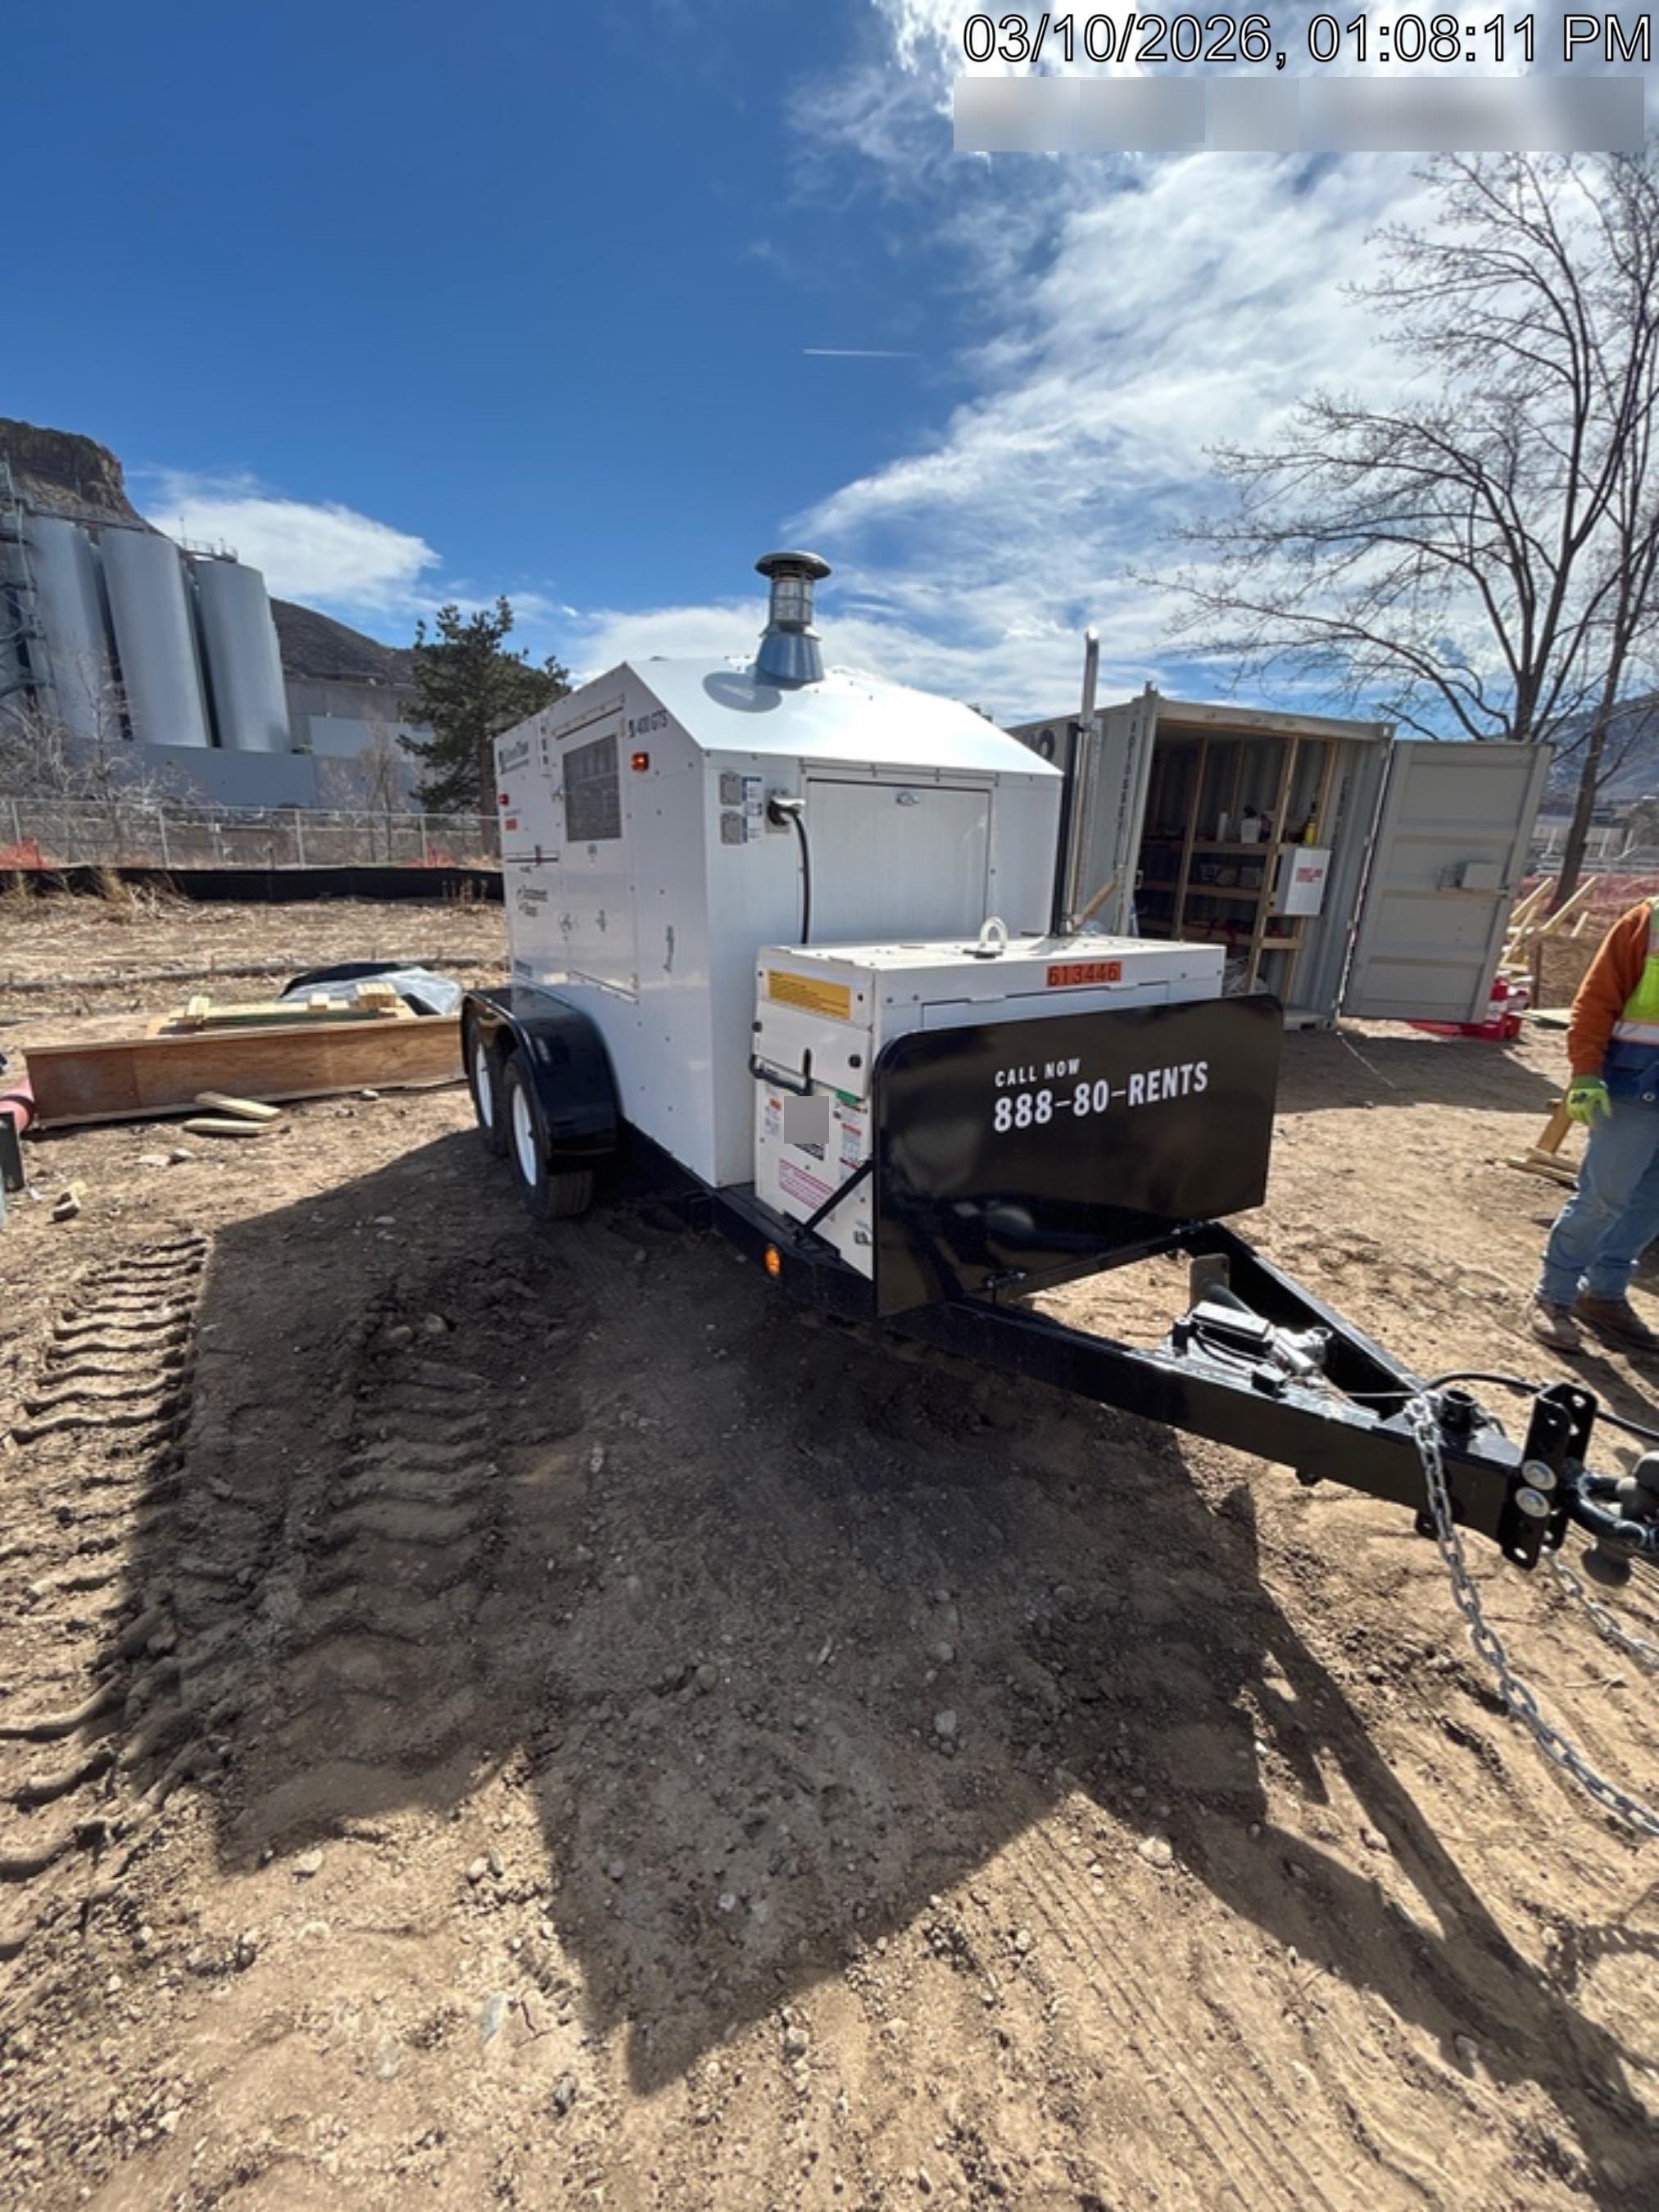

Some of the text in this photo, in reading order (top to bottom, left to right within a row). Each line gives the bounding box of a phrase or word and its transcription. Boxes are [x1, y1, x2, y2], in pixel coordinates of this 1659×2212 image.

[1049, 961, 1122, 986] 613446
[995, 1058, 1081, 1087] CALL NOW
[993, 1061, 1208, 1133] 888-80-RENTS
